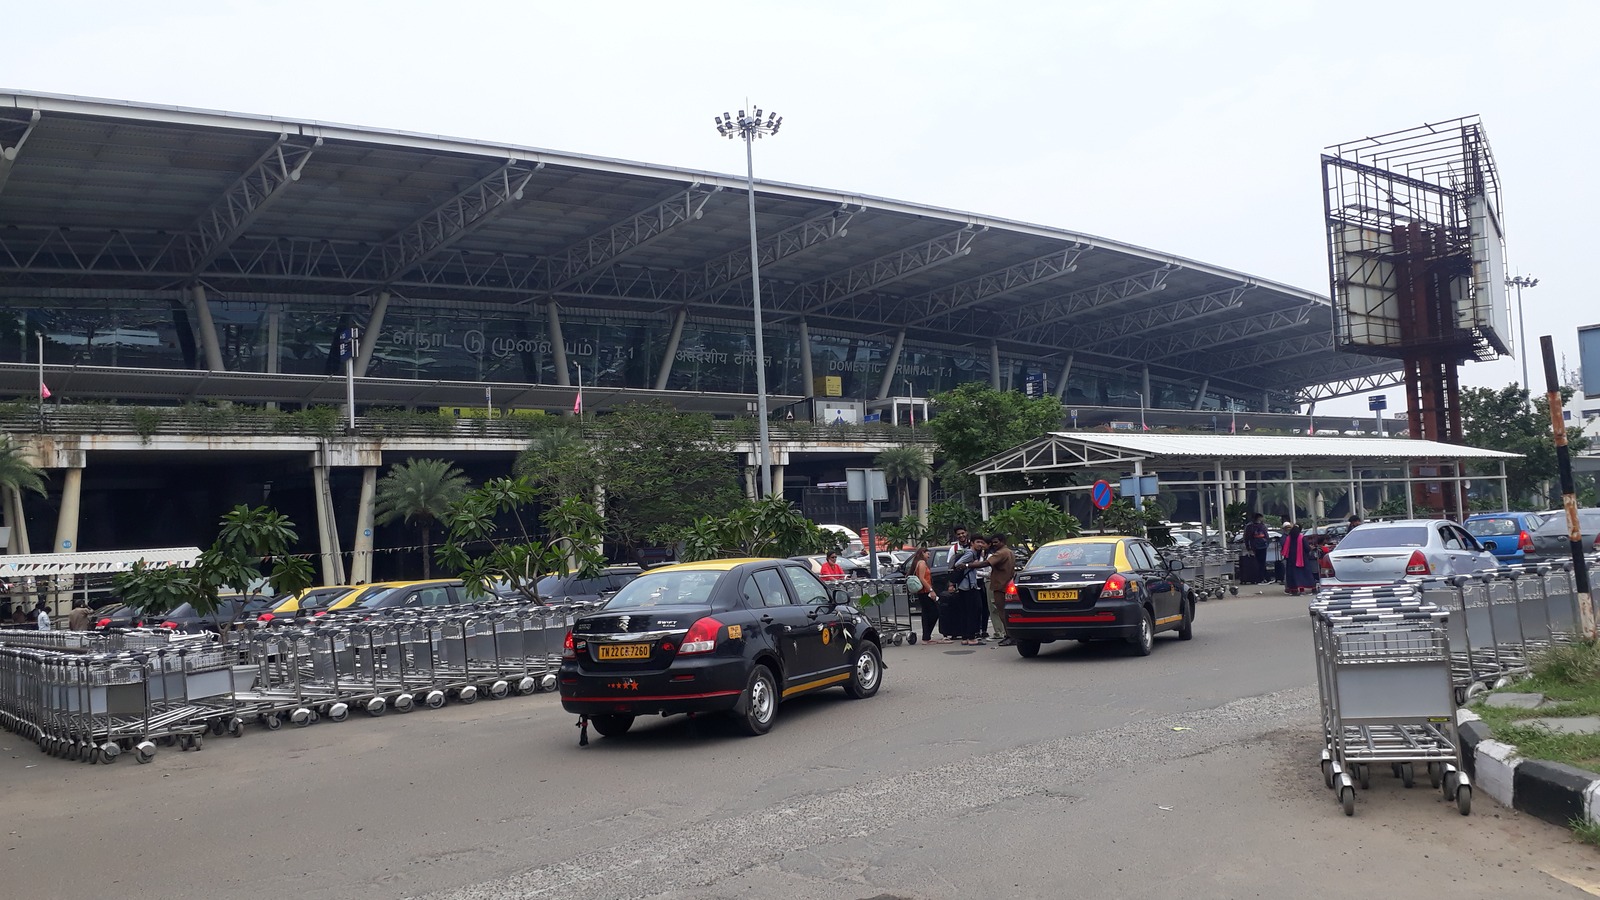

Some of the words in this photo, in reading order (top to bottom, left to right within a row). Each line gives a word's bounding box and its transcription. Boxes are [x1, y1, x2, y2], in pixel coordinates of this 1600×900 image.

[829, 360, 881, 373] DOMESTIC
[895, 363, 933, 376] RMINAL
[601, 647, 609, 657] TN
[610, 646, 620, 657] 22
[630, 646, 648, 657] 7260
